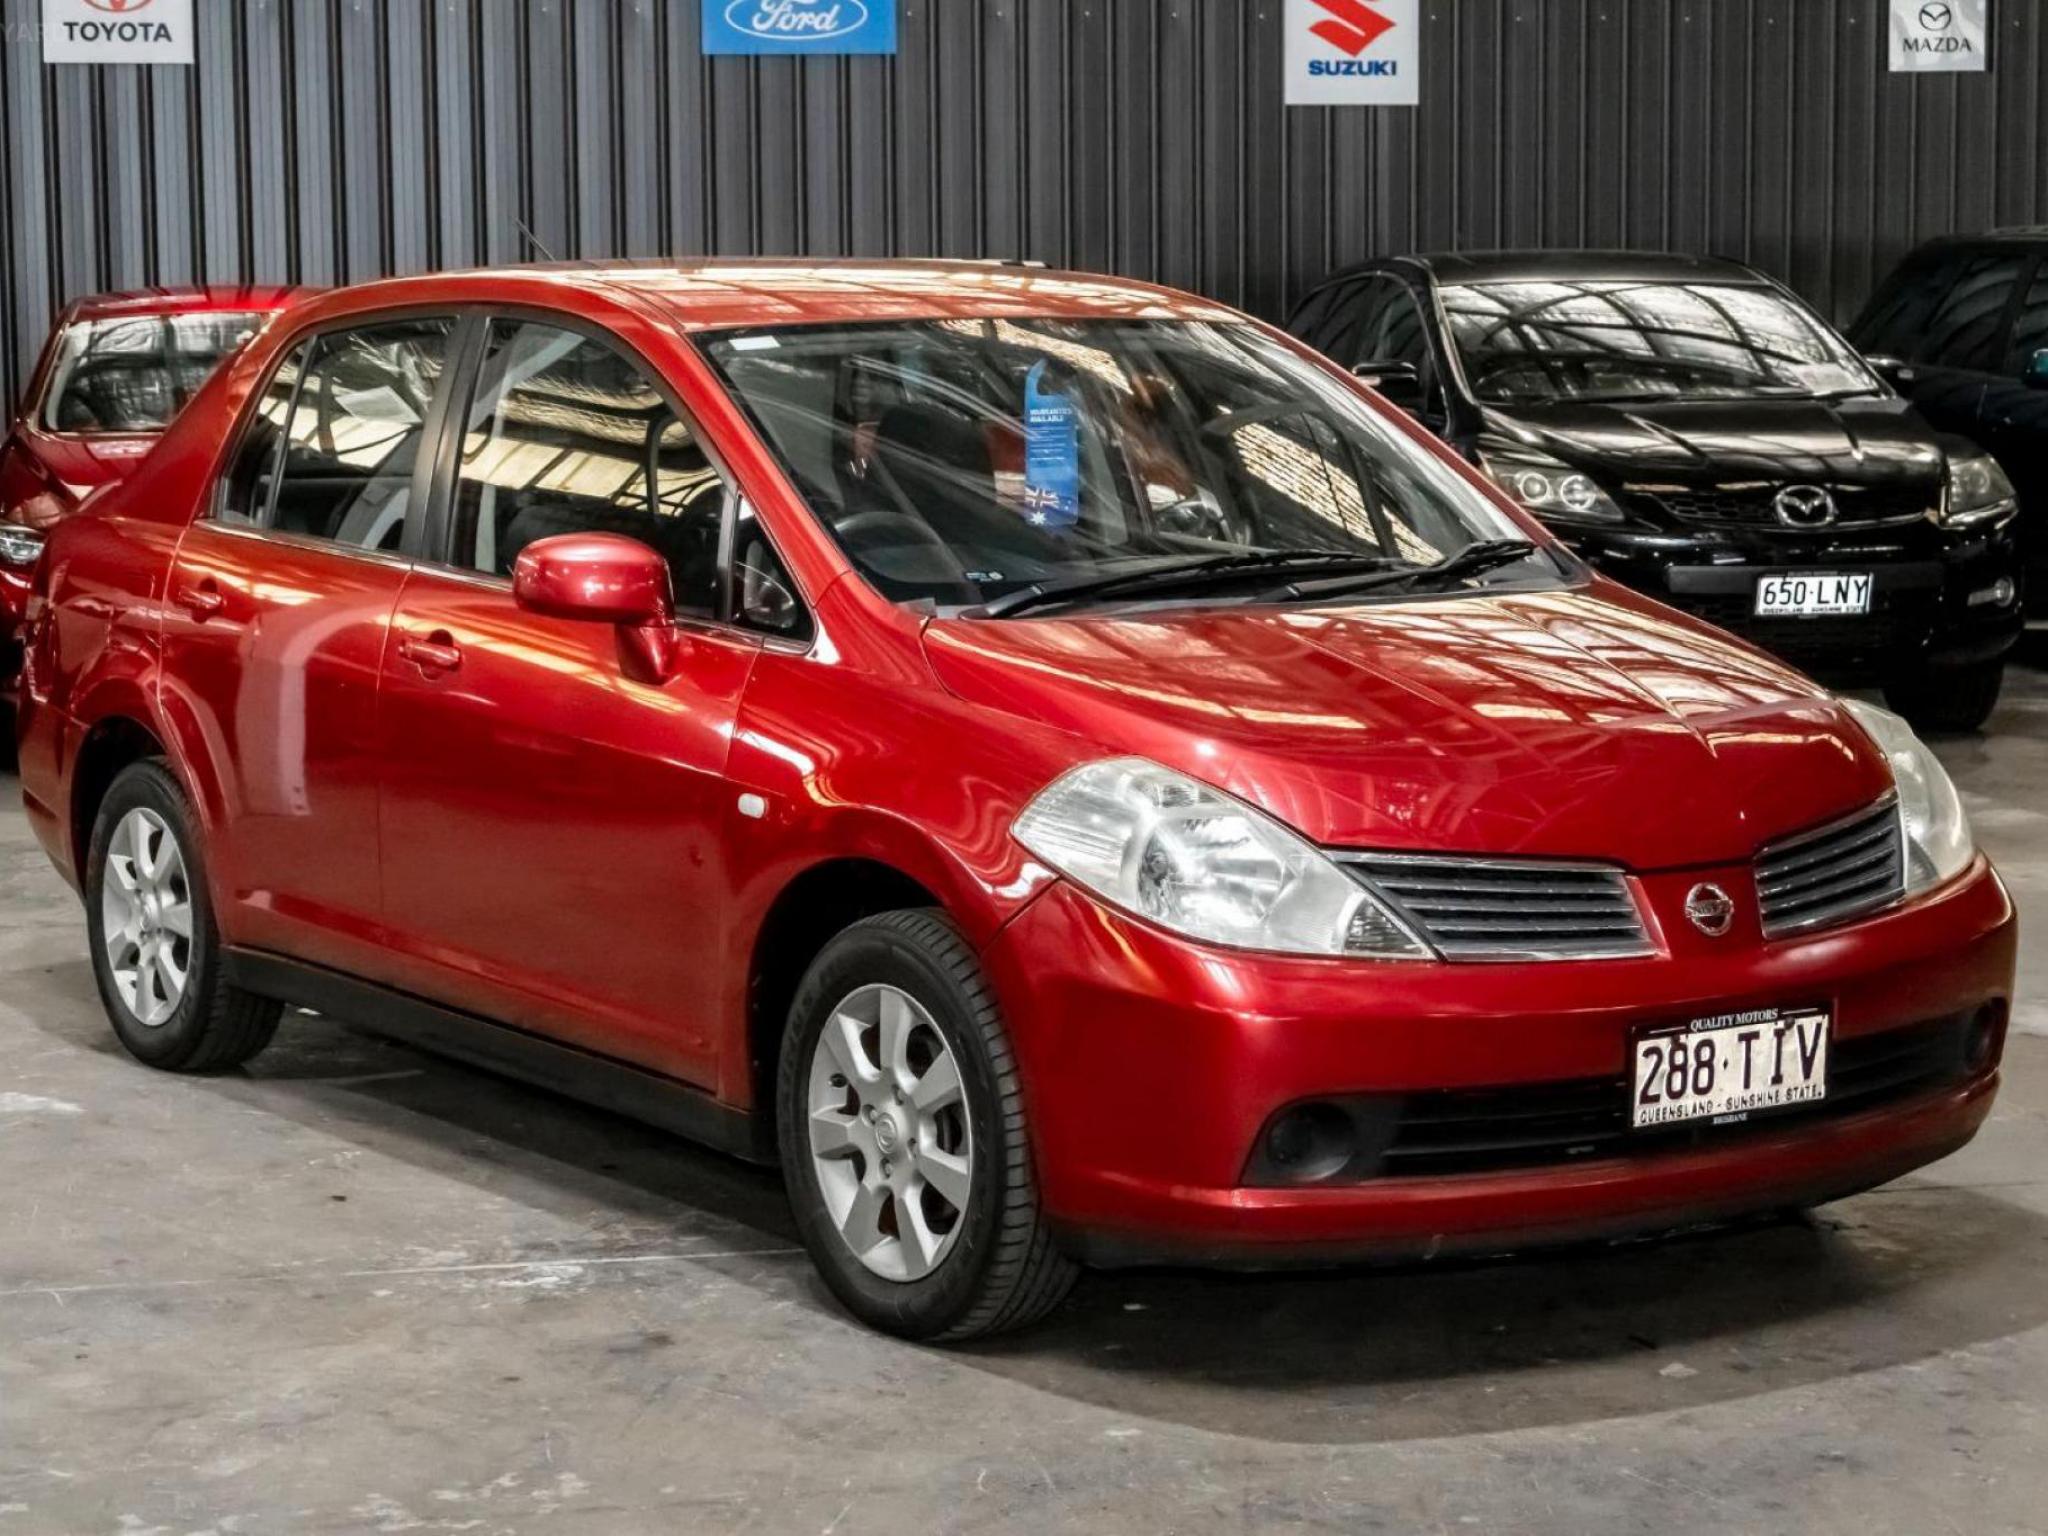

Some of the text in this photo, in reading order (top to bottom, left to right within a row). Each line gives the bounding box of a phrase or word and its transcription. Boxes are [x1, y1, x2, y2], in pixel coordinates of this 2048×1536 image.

[752, 0, 841, 31] Ford
[63, 22, 172, 42] TOYOTA
[1902, 37, 1972, 52] MAZDA
[1308, 60, 1397, 76] SUZUKI
[1690, 1007, 1779, 1033] QUALITY MOTORS
[1640, 1100, 1714, 1124] QUEENSLAND
[1726, 1089, 1780, 1112] SUNSHINE
